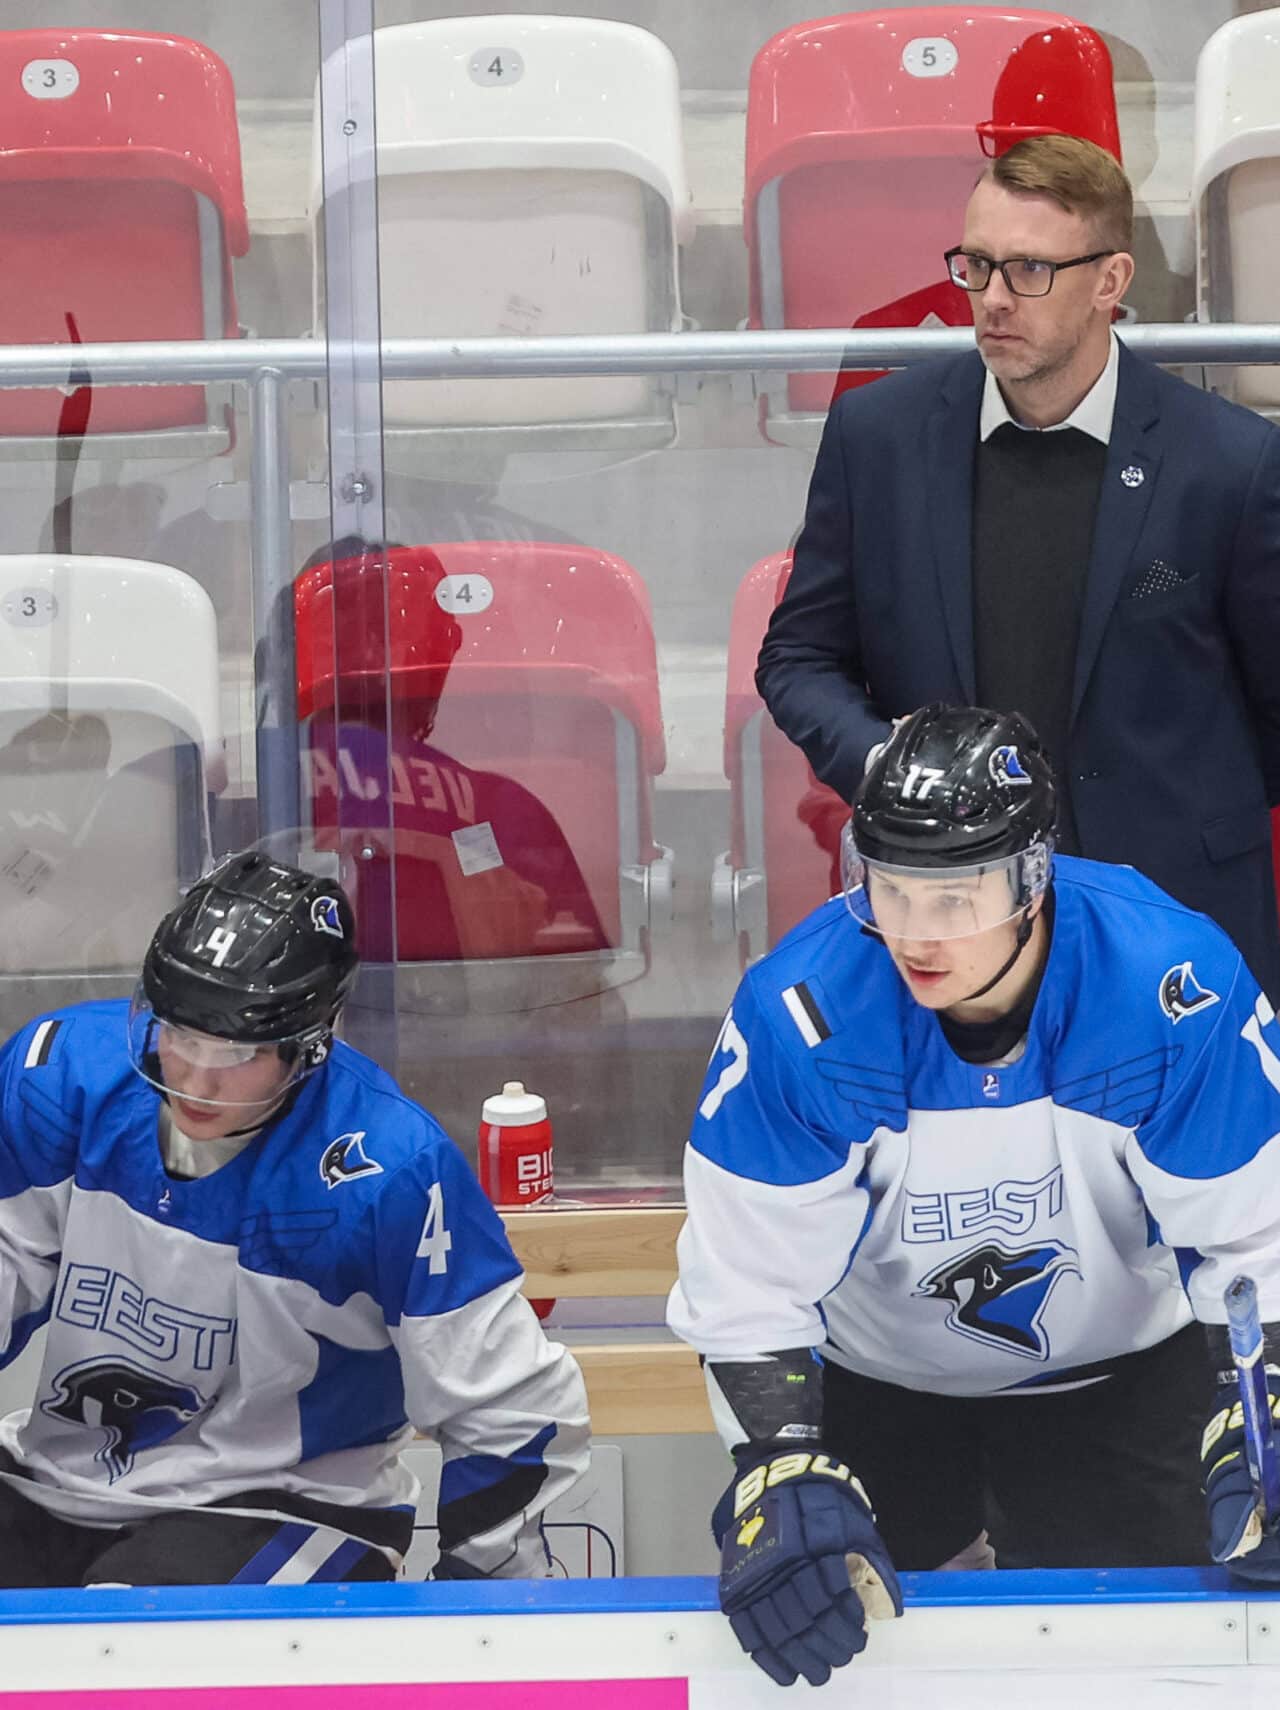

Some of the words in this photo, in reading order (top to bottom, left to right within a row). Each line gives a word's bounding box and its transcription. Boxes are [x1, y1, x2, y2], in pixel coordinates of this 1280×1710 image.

[487, 57, 504, 77] 4
[921, 46, 937, 67] 5
[42, 68, 57, 88] 3
[455, 583, 473, 603] 4
[22, 597, 37, 617] 3
[902, 765, 945, 800] 17
[206, 927, 237, 968] 4
[699, 1006, 749, 1121] 7
[517, 1147, 553, 1181] BI
[416, 1182, 452, 1276] 4
